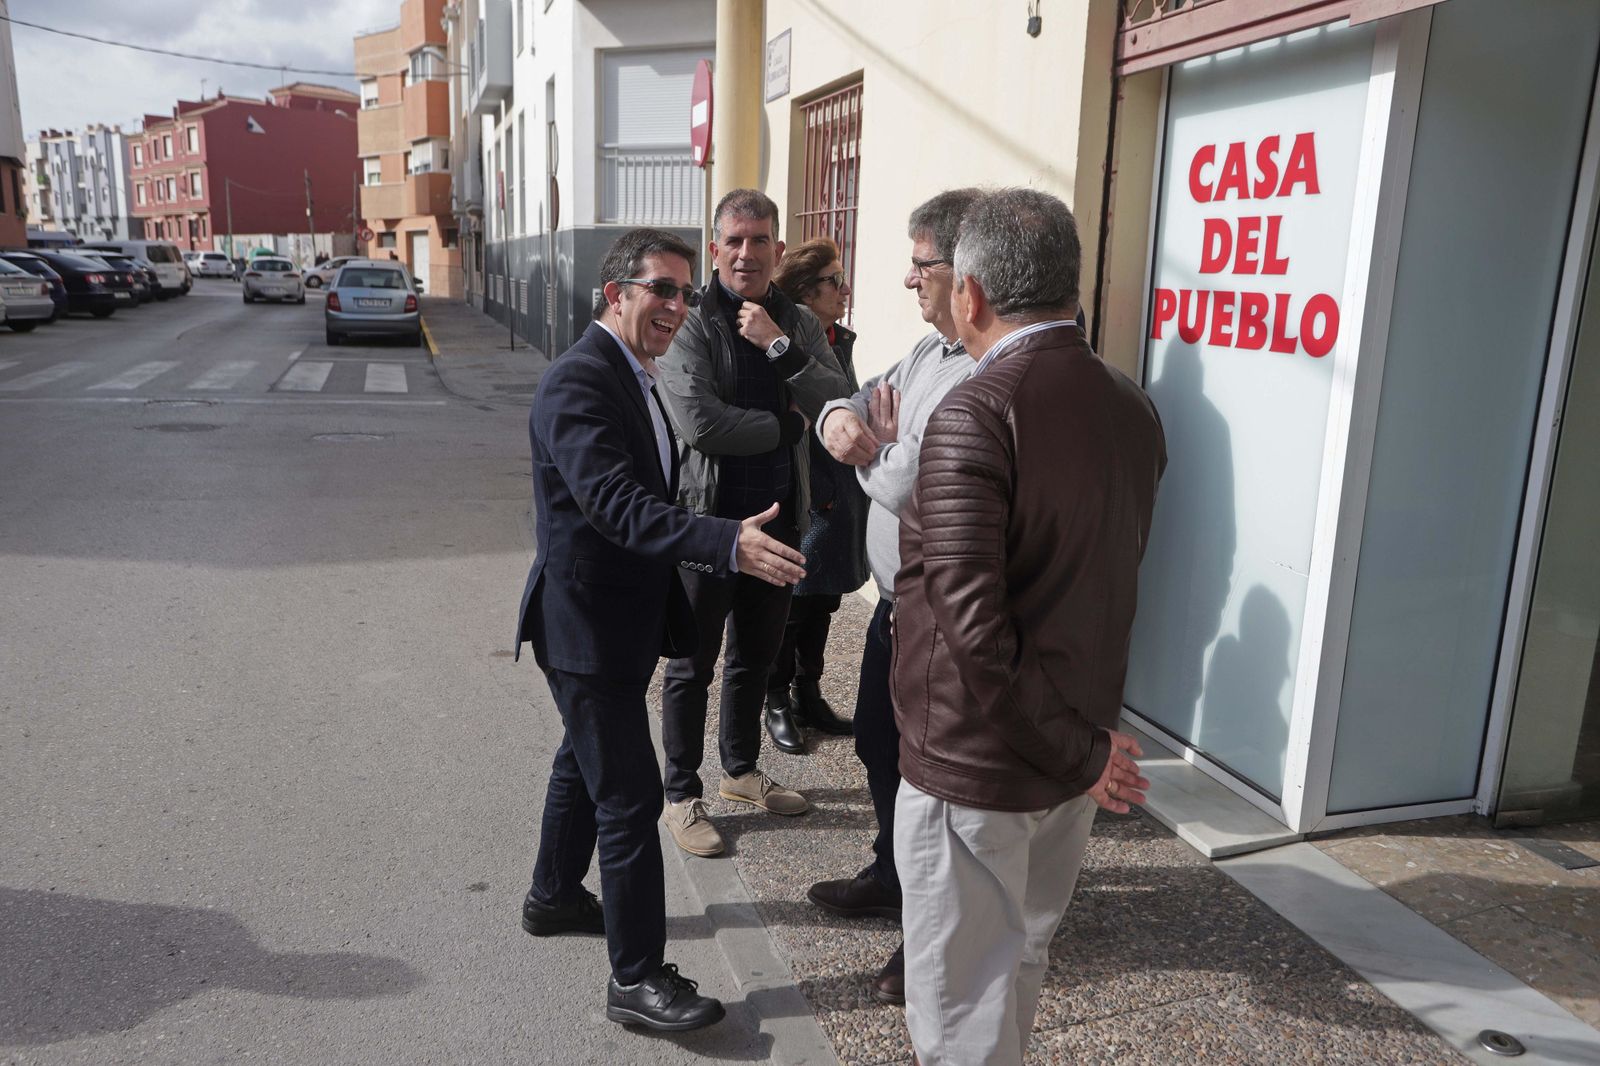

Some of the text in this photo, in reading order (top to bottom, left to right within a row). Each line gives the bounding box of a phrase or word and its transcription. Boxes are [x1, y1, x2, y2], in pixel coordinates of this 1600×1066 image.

[1189, 132, 1320, 203] CASA
[1199, 215, 1289, 275] DEL
[1150, 288, 1340, 358] PUEBLO
